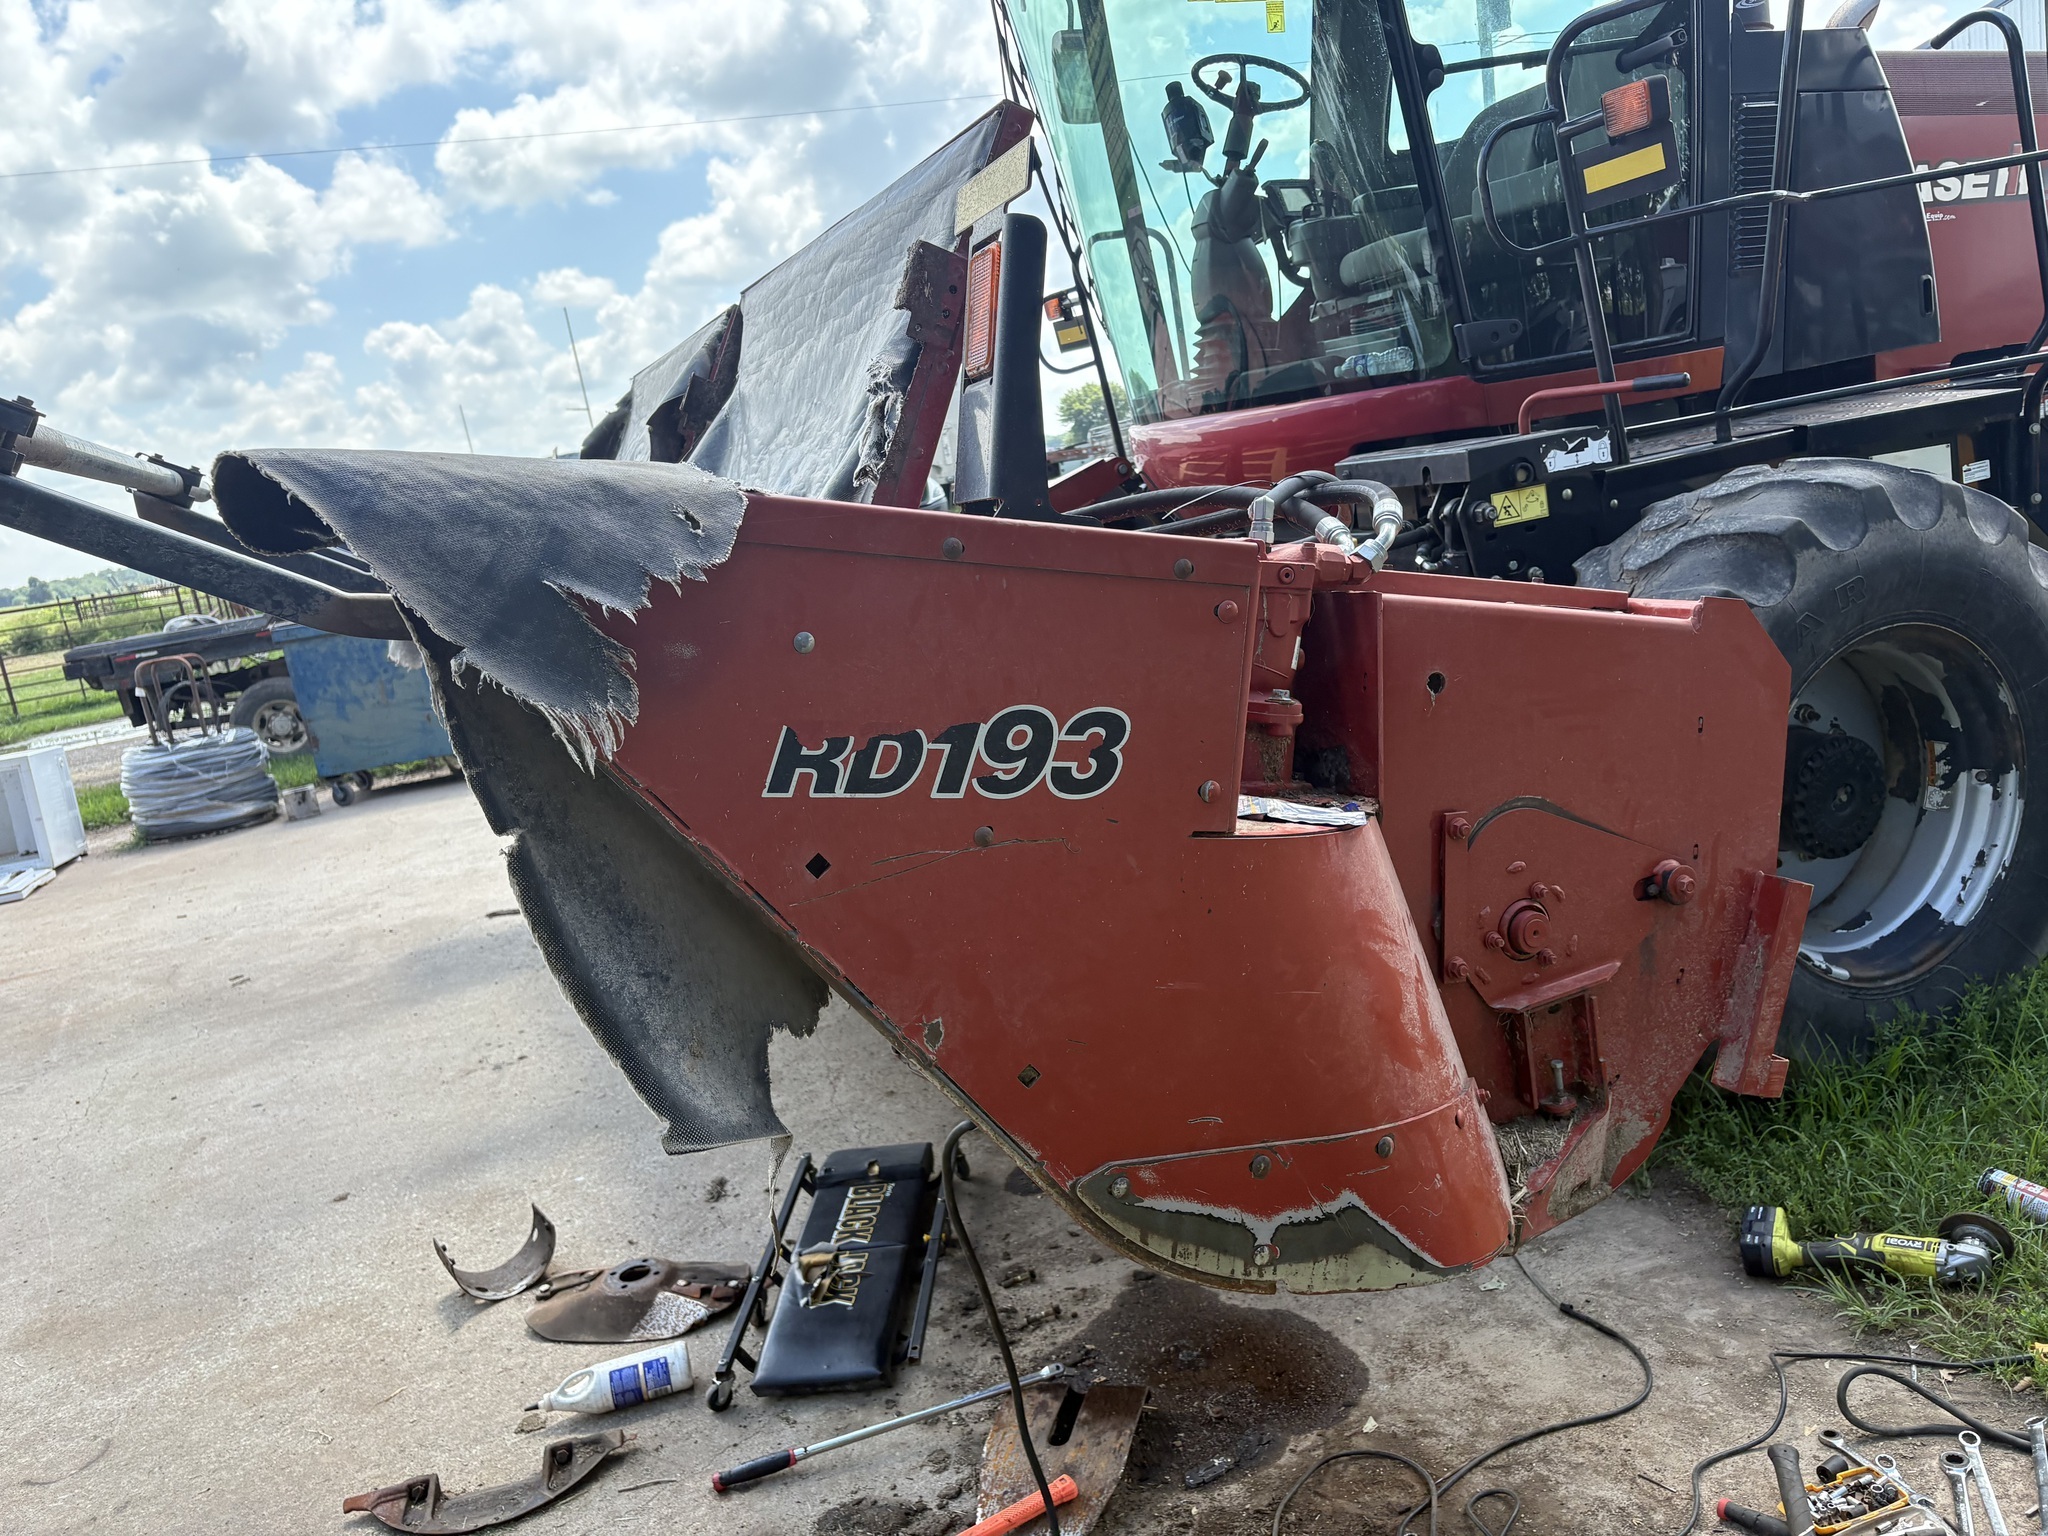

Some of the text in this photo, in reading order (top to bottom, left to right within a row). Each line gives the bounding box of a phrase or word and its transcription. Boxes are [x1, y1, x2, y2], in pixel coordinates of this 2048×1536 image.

[761, 704, 1132, 800] RD193
[830, 1183, 887, 1245] BLACK
[1885, 1236, 1923, 1249] RYOBI
